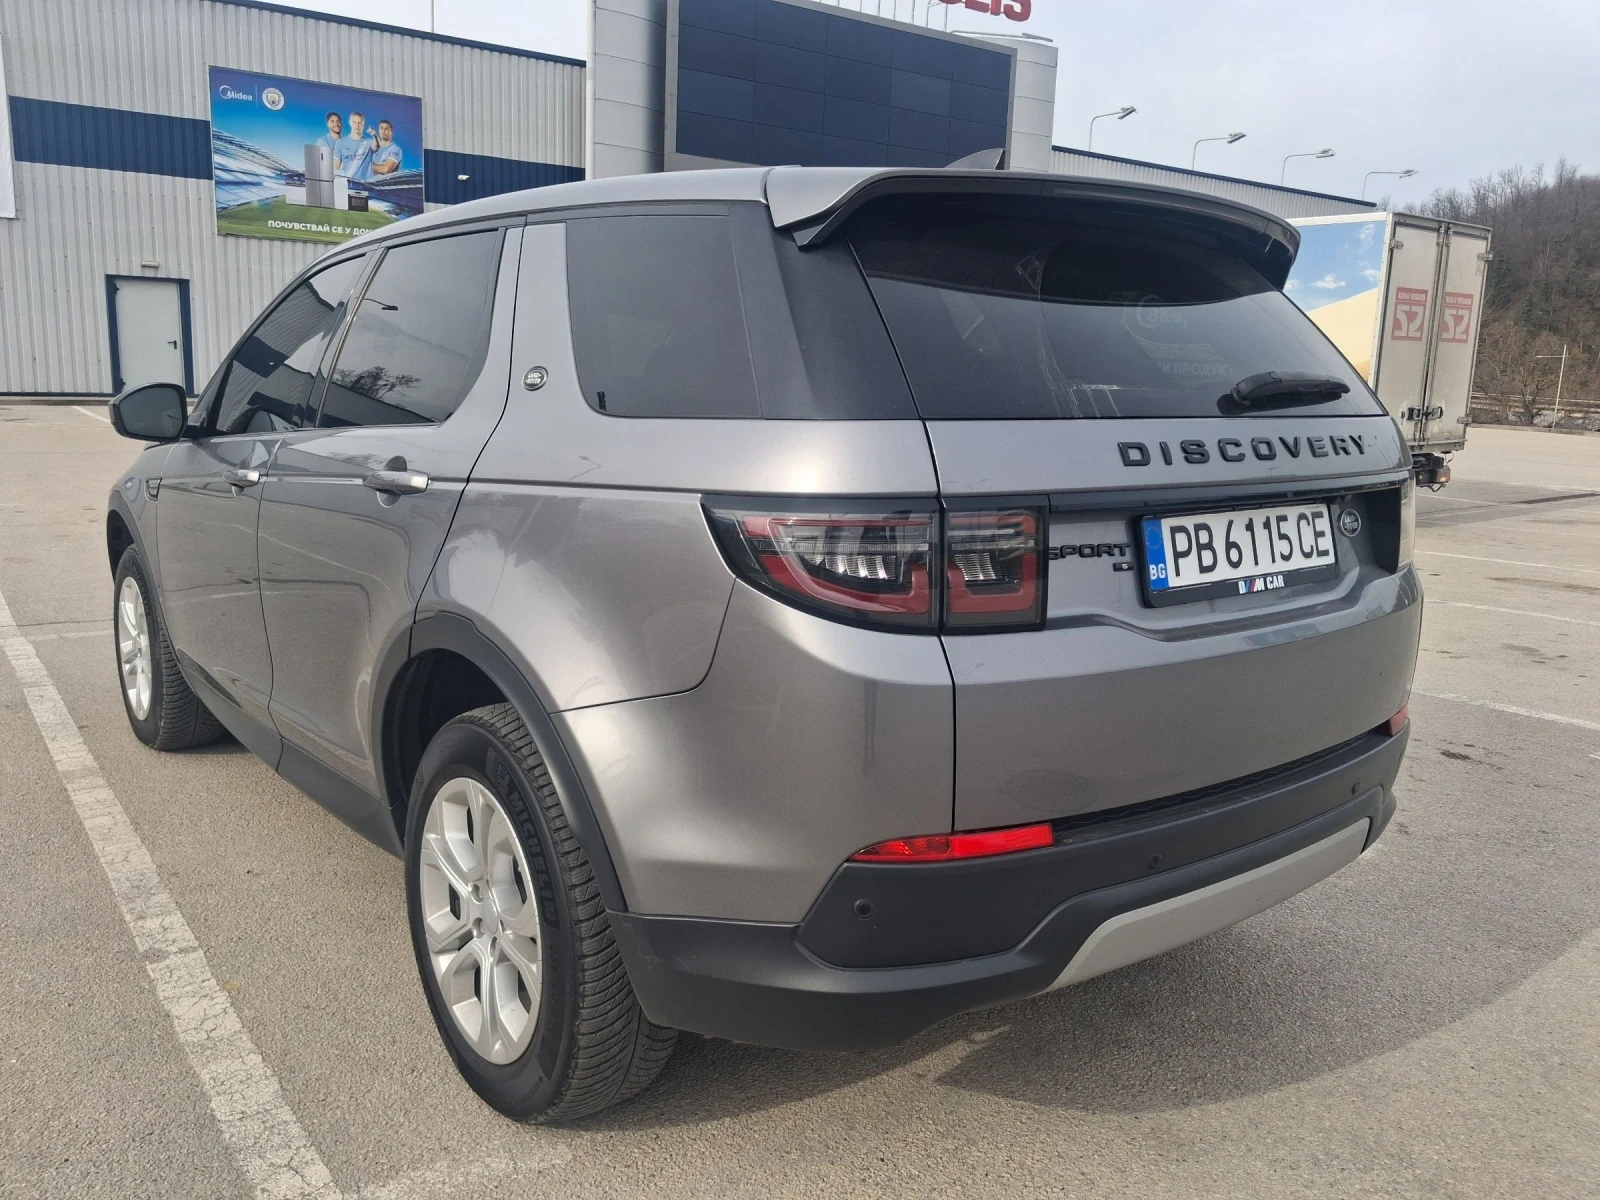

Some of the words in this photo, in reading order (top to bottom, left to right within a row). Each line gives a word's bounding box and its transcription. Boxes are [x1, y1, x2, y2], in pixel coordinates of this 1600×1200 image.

[219, 85, 252, 101] Midea
[267, 220, 330, 233] ПОЧУВСТВАЙ
[331, 226, 344, 234] СЕ
[1117, 434, 1367, 467] DISCOVERY
[1048, 543, 1131, 560] SPORT
[1149, 563, 1166, 580] BG
[1266, 575, 1285, 590] CAR
[509, 790, 558, 925] MICHELIN
